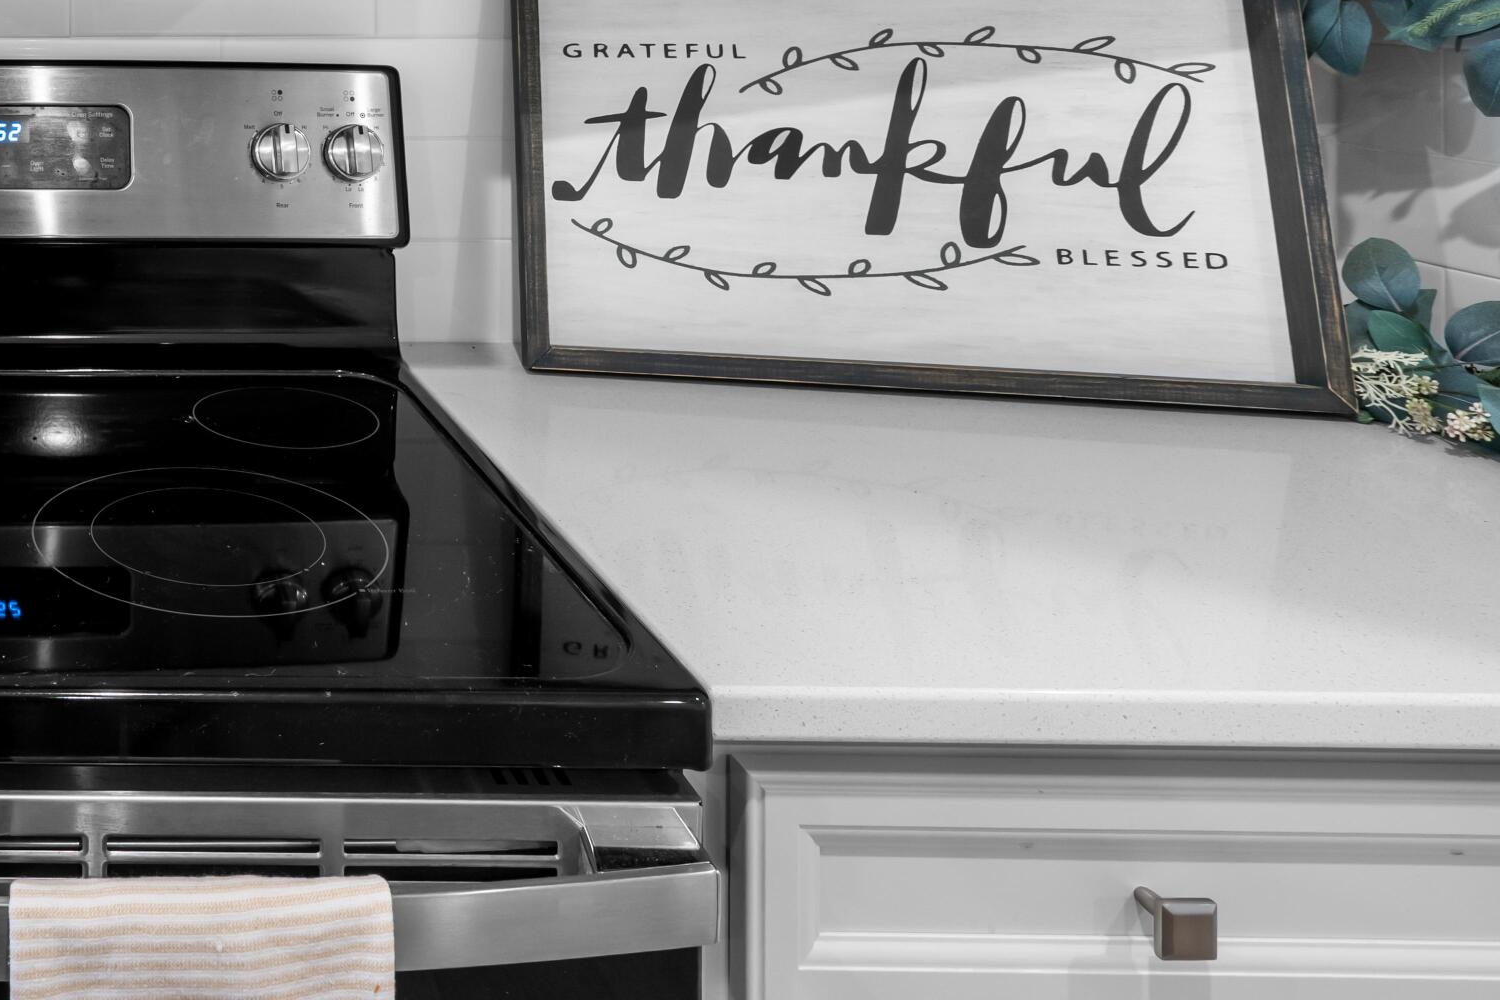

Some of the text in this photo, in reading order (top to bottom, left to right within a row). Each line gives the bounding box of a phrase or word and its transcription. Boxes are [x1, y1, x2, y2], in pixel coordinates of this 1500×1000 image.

[562, 42, 747, 59] GRATEFUL
[551, 57, 1196, 248] thankful
[1056, 248, 1228, 270] BLESSED
